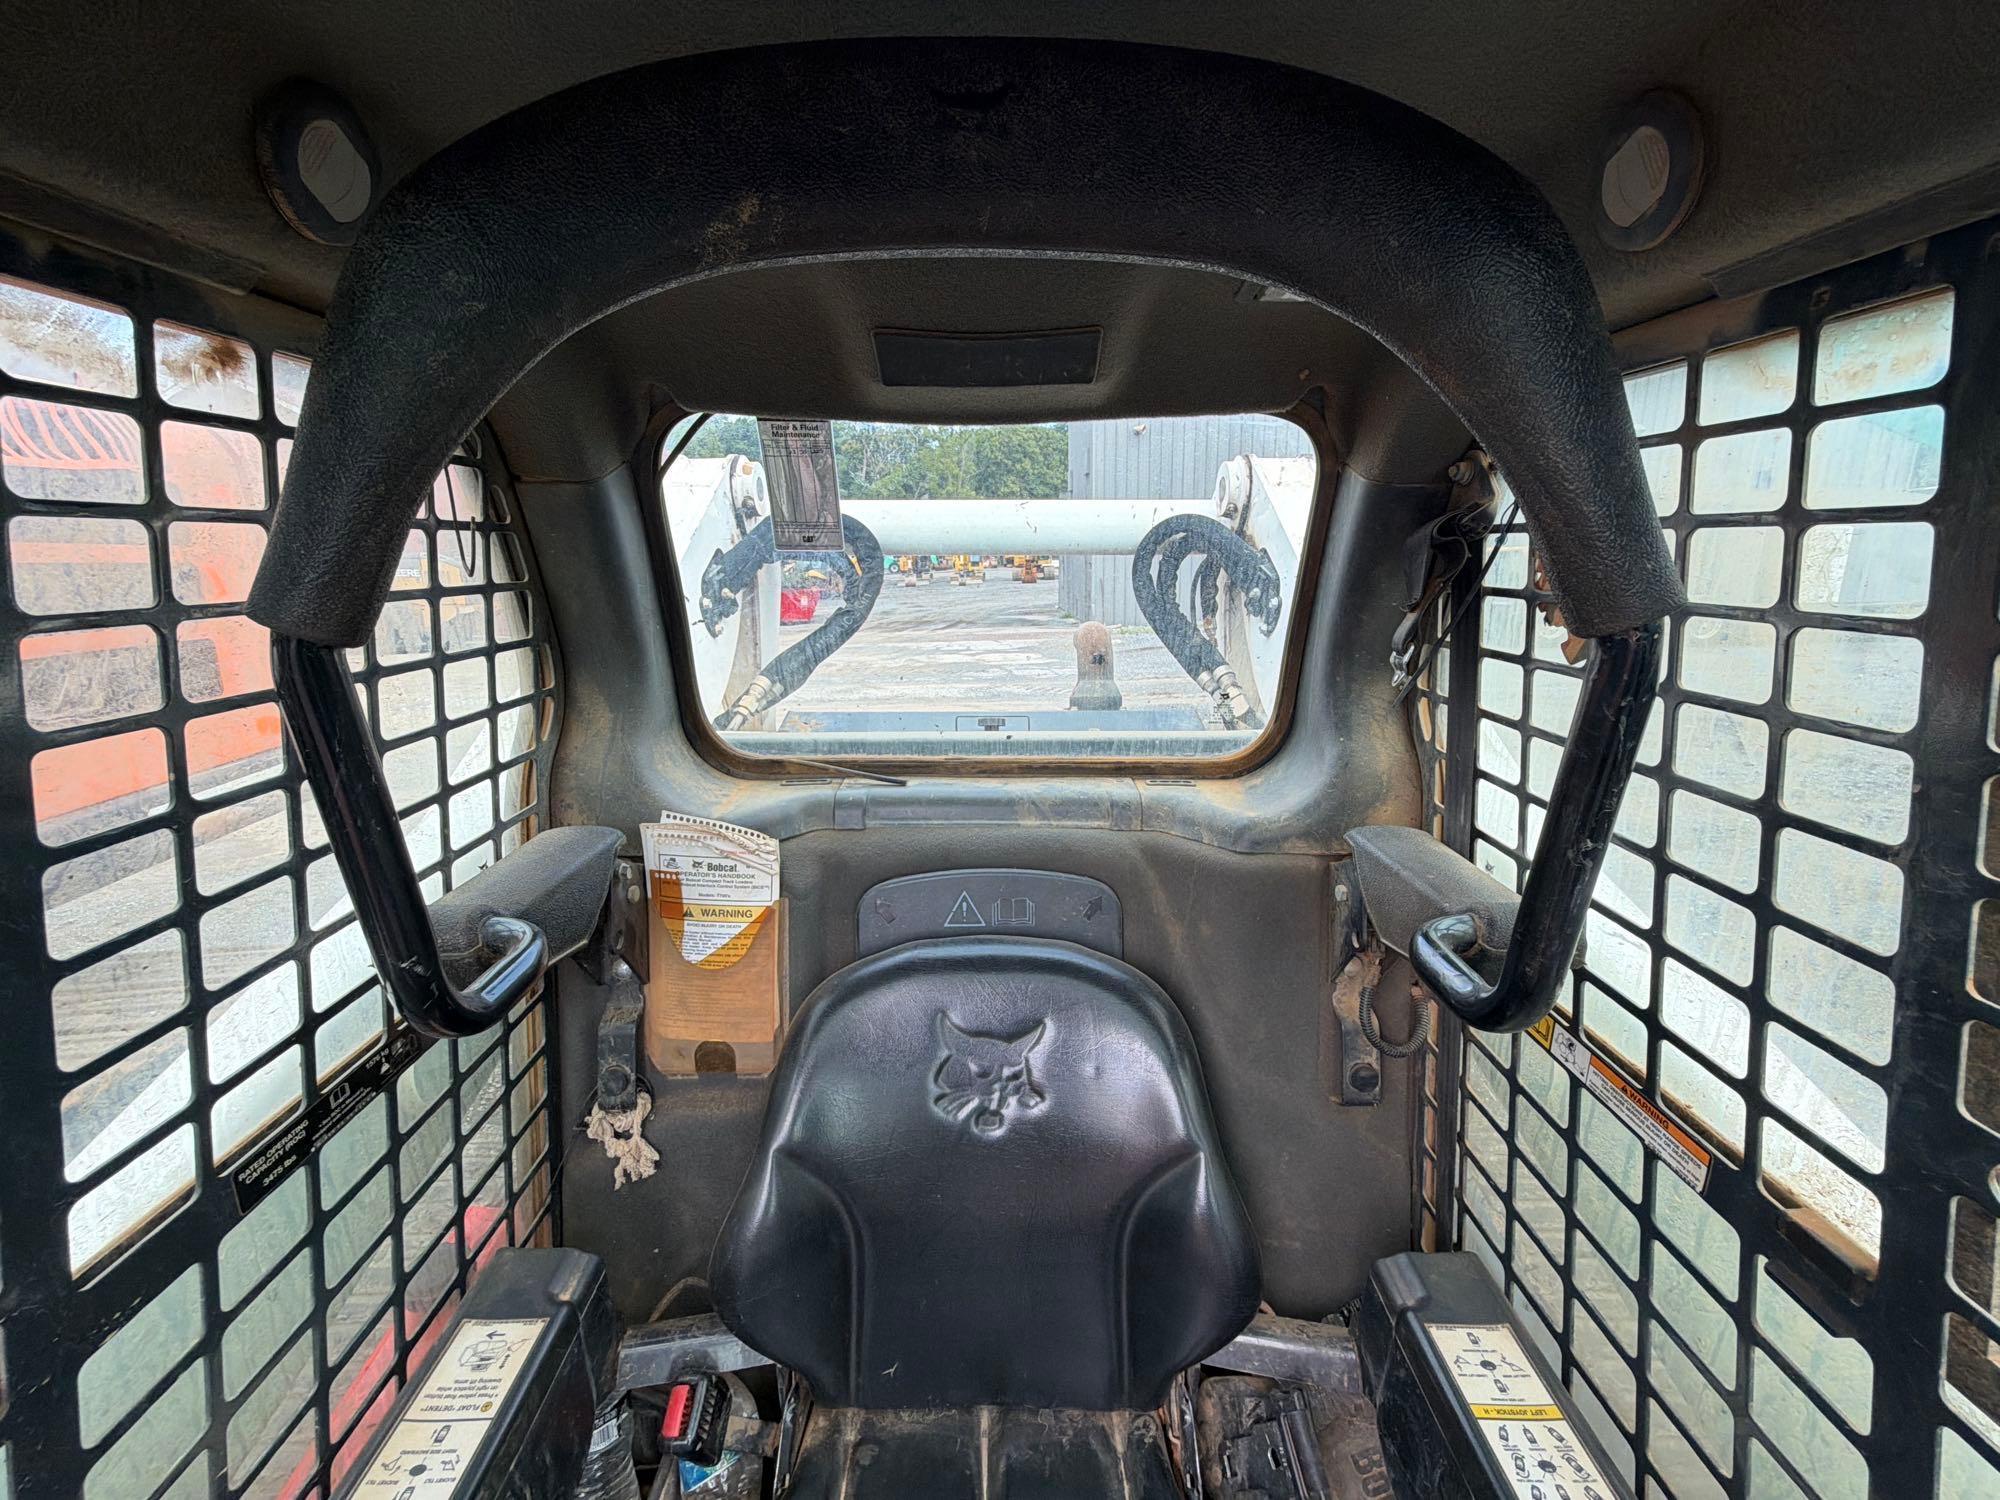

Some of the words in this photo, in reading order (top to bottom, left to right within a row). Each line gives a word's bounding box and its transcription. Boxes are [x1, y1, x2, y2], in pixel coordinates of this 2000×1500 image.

[802, 535, 814, 543] CAT
[707, 863, 738, 872] Bobcat
[700, 908, 753, 918] WARNING
[1628, 1090, 1670, 1130] WARNING
[238, 1156, 266, 1182] RATED
[266, 1120, 309, 1158] OPERATING
[245, 1148, 284, 1184] CAPACITY
[285, 1129, 306, 1151] (ROC)
[262, 1165, 284, 1186] 3475
[284, 1154, 297, 1168] lbs
[1494, 1408, 1528, 1416] JOYSTICK
[1530, 1408, 1548, 1416] LEFT
